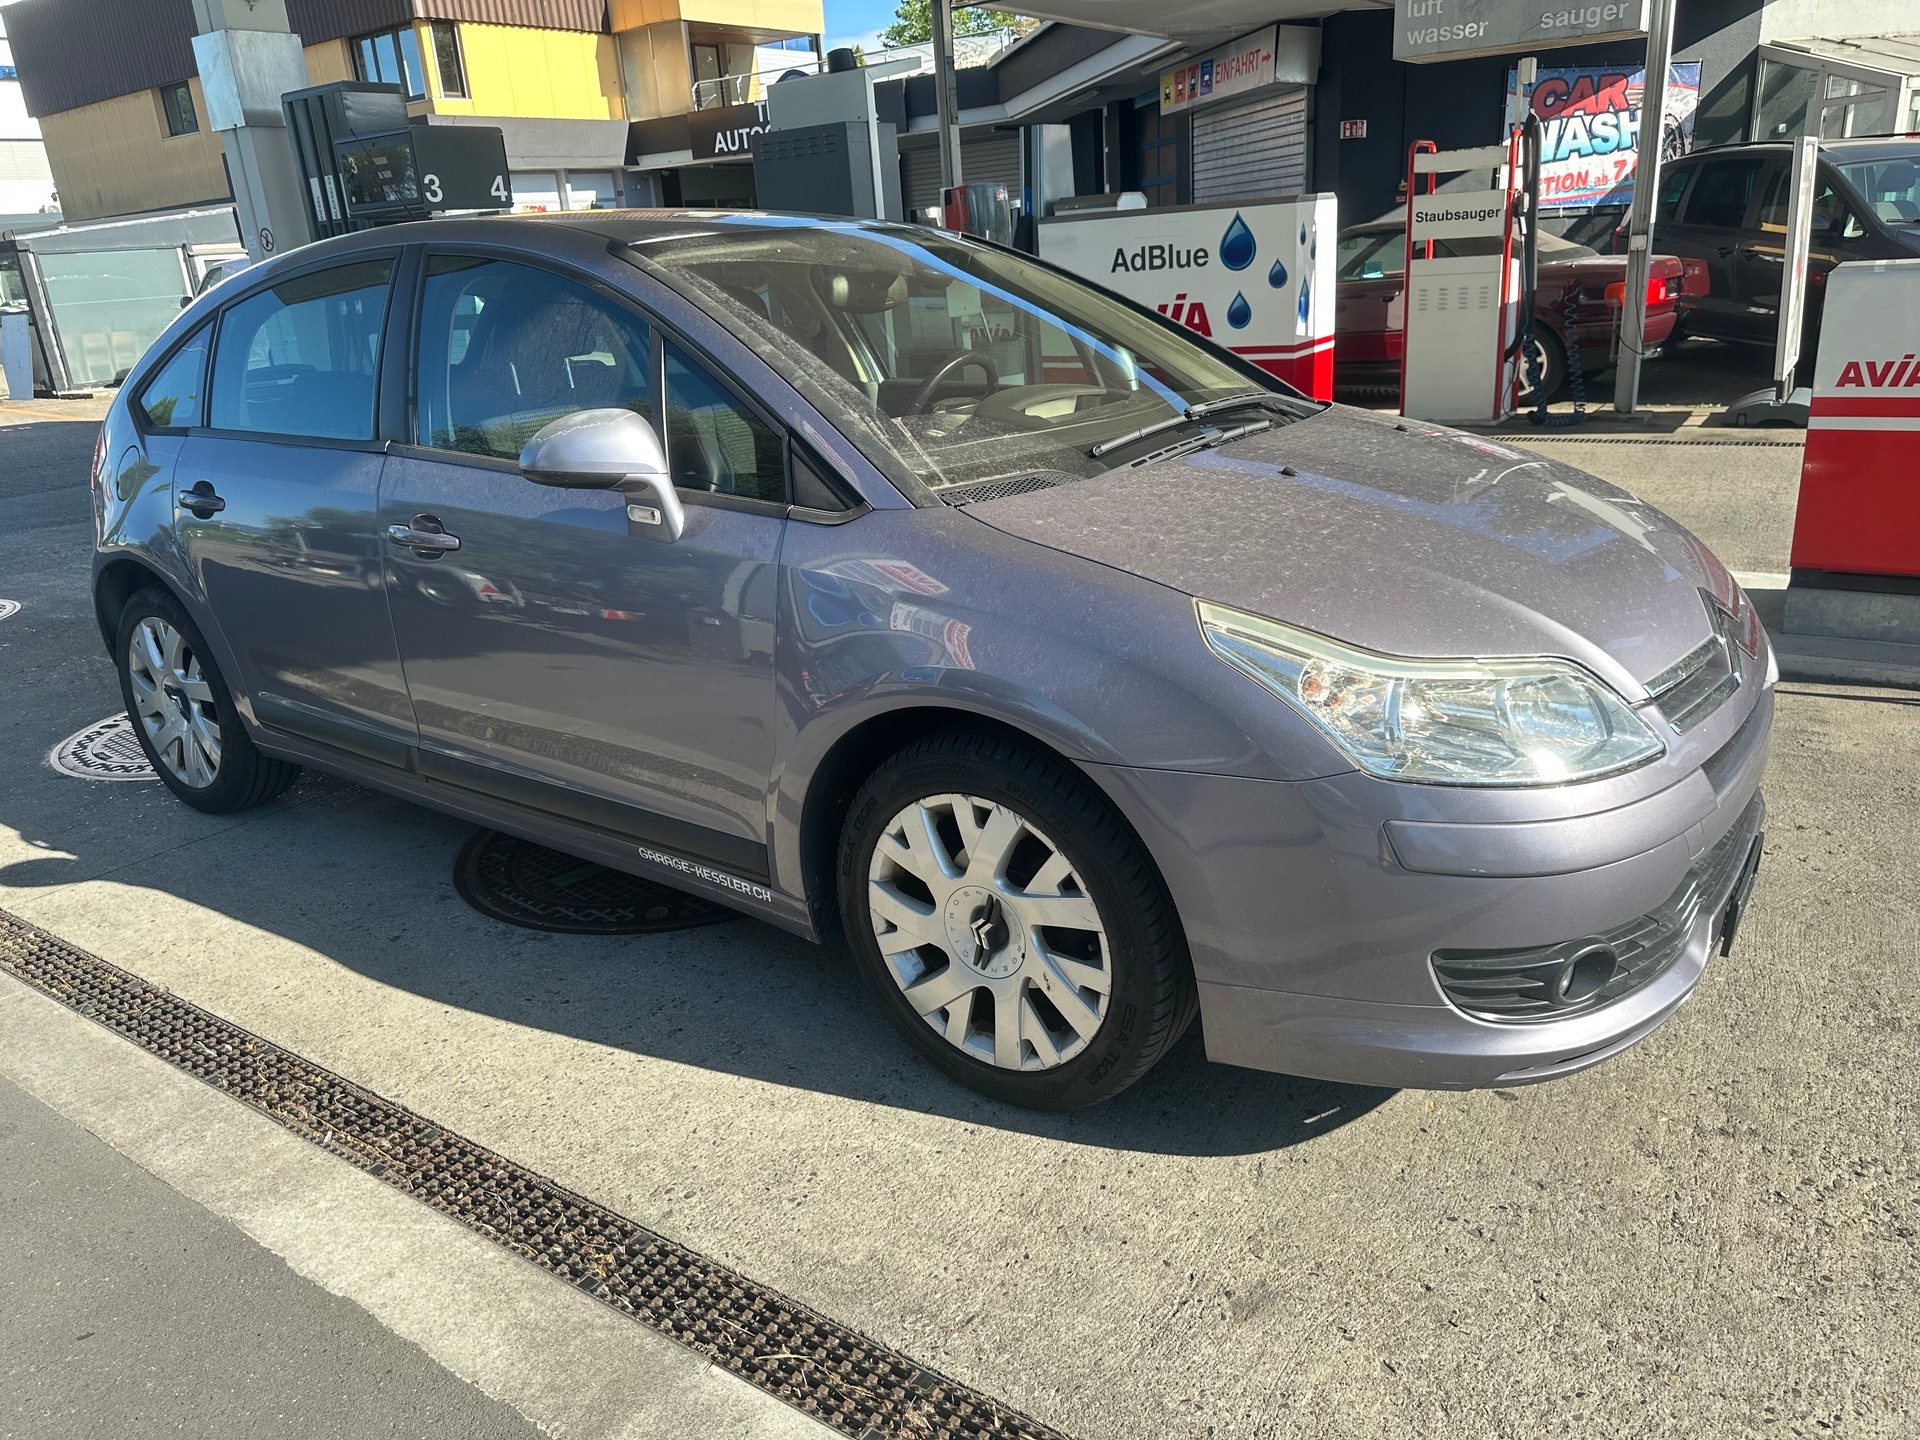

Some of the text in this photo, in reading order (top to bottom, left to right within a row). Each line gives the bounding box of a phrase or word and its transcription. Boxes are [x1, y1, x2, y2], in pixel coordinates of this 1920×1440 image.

[1407, 0, 1443, 18] luft
[1540, 1, 1629, 28] sauger
[1407, 20, 1489, 45] wasser
[1215, 48, 1261, 84] EINFAHRT
[1532, 73, 1629, 119] CAR
[424, 174, 508, 202] 3 4
[1415, 208, 1501, 223] Staubsauger
[1110, 243, 1209, 274] AdBlue
[1003, 780, 1045, 810] SPIRIT
[638, 847, 772, 903] GARAGE-KESSLER.CH
